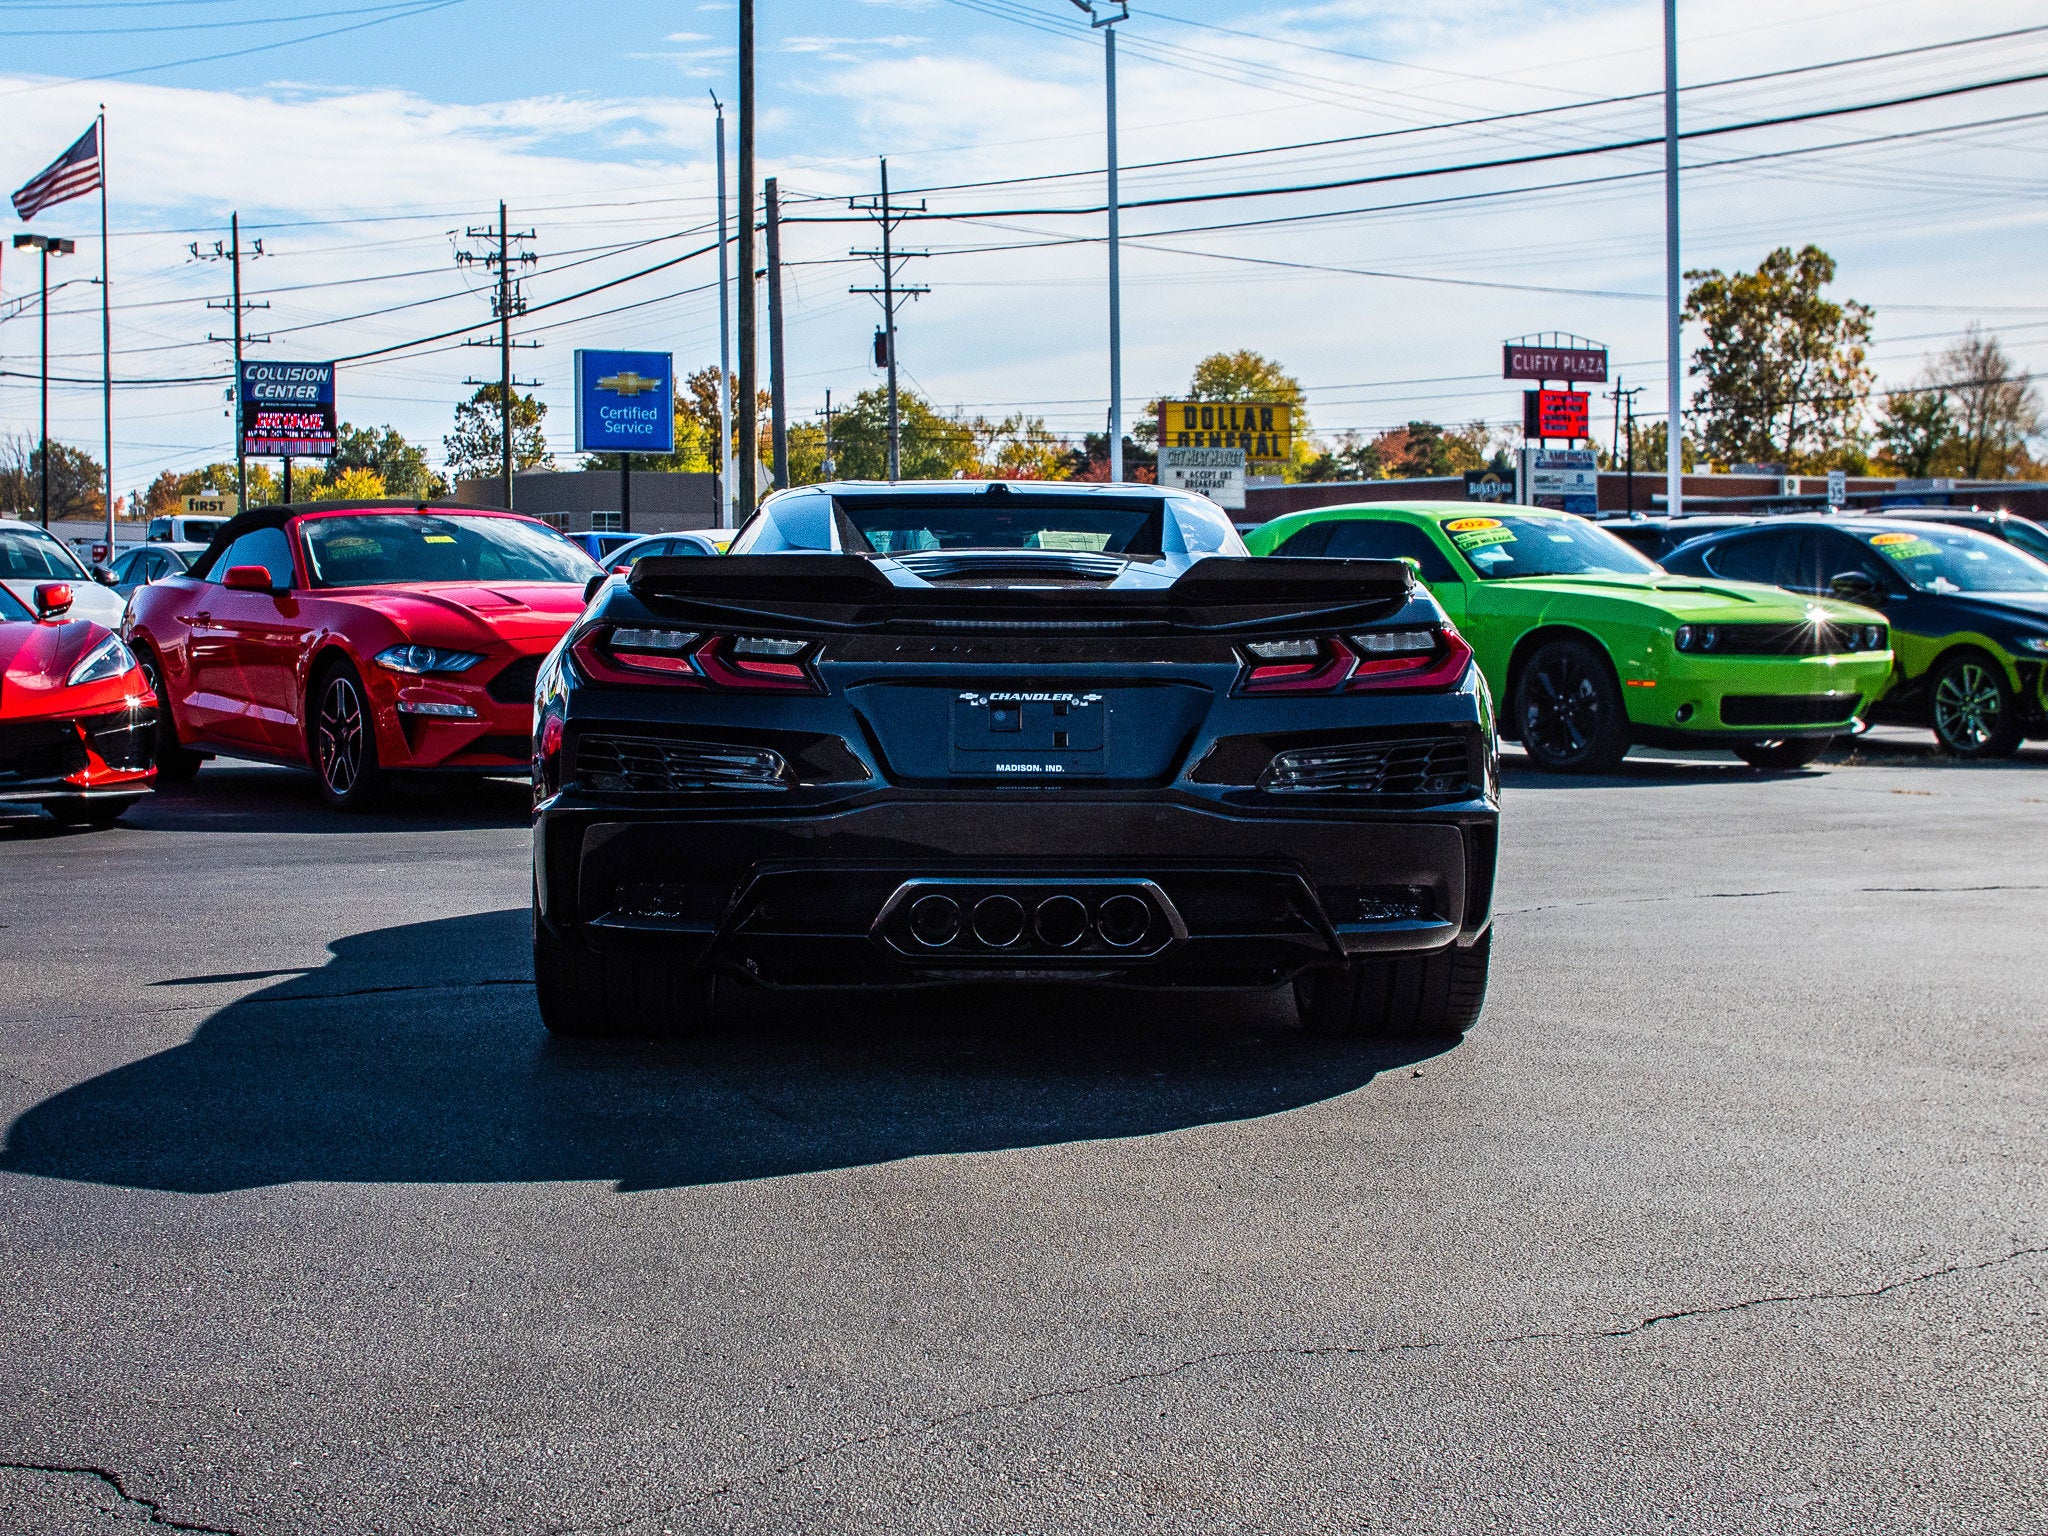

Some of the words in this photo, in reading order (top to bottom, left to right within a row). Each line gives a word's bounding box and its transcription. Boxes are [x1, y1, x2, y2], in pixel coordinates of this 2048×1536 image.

[1512, 354, 1558, 372] CLIFTY
[1563, 356, 1605, 373] PLAZA
[245, 365, 329, 382] COLLISION
[254, 383, 317, 399] CENTER
[600, 406, 657, 420] Certified
[1184, 405, 1274, 431] DOLLAR
[605, 420, 653, 434] Service
[1189, 470, 1216, 479] ACCEPT
[1185, 479, 1225, 488] BREAKFAST
[989, 693, 1073, 701] CHANDLER
[1045, 764, 1065, 772] IND.
